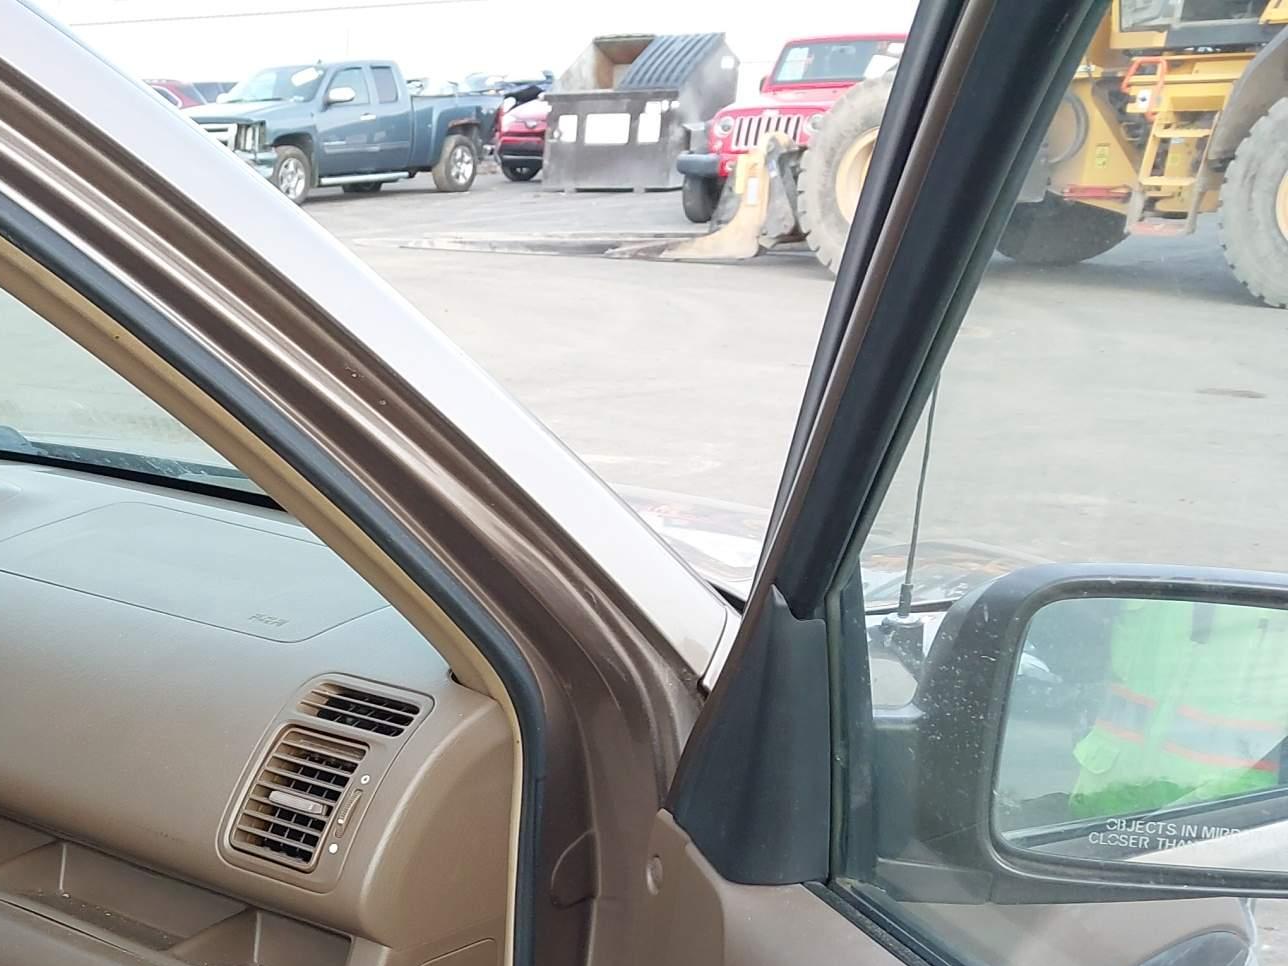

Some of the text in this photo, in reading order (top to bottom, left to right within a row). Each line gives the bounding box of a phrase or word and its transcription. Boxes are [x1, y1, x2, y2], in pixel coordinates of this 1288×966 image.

[1106, 818, 1177, 836] OBJECTS
[1181, 824, 1198, 838] IN
[1088, 831, 1150, 849] CLOSER
